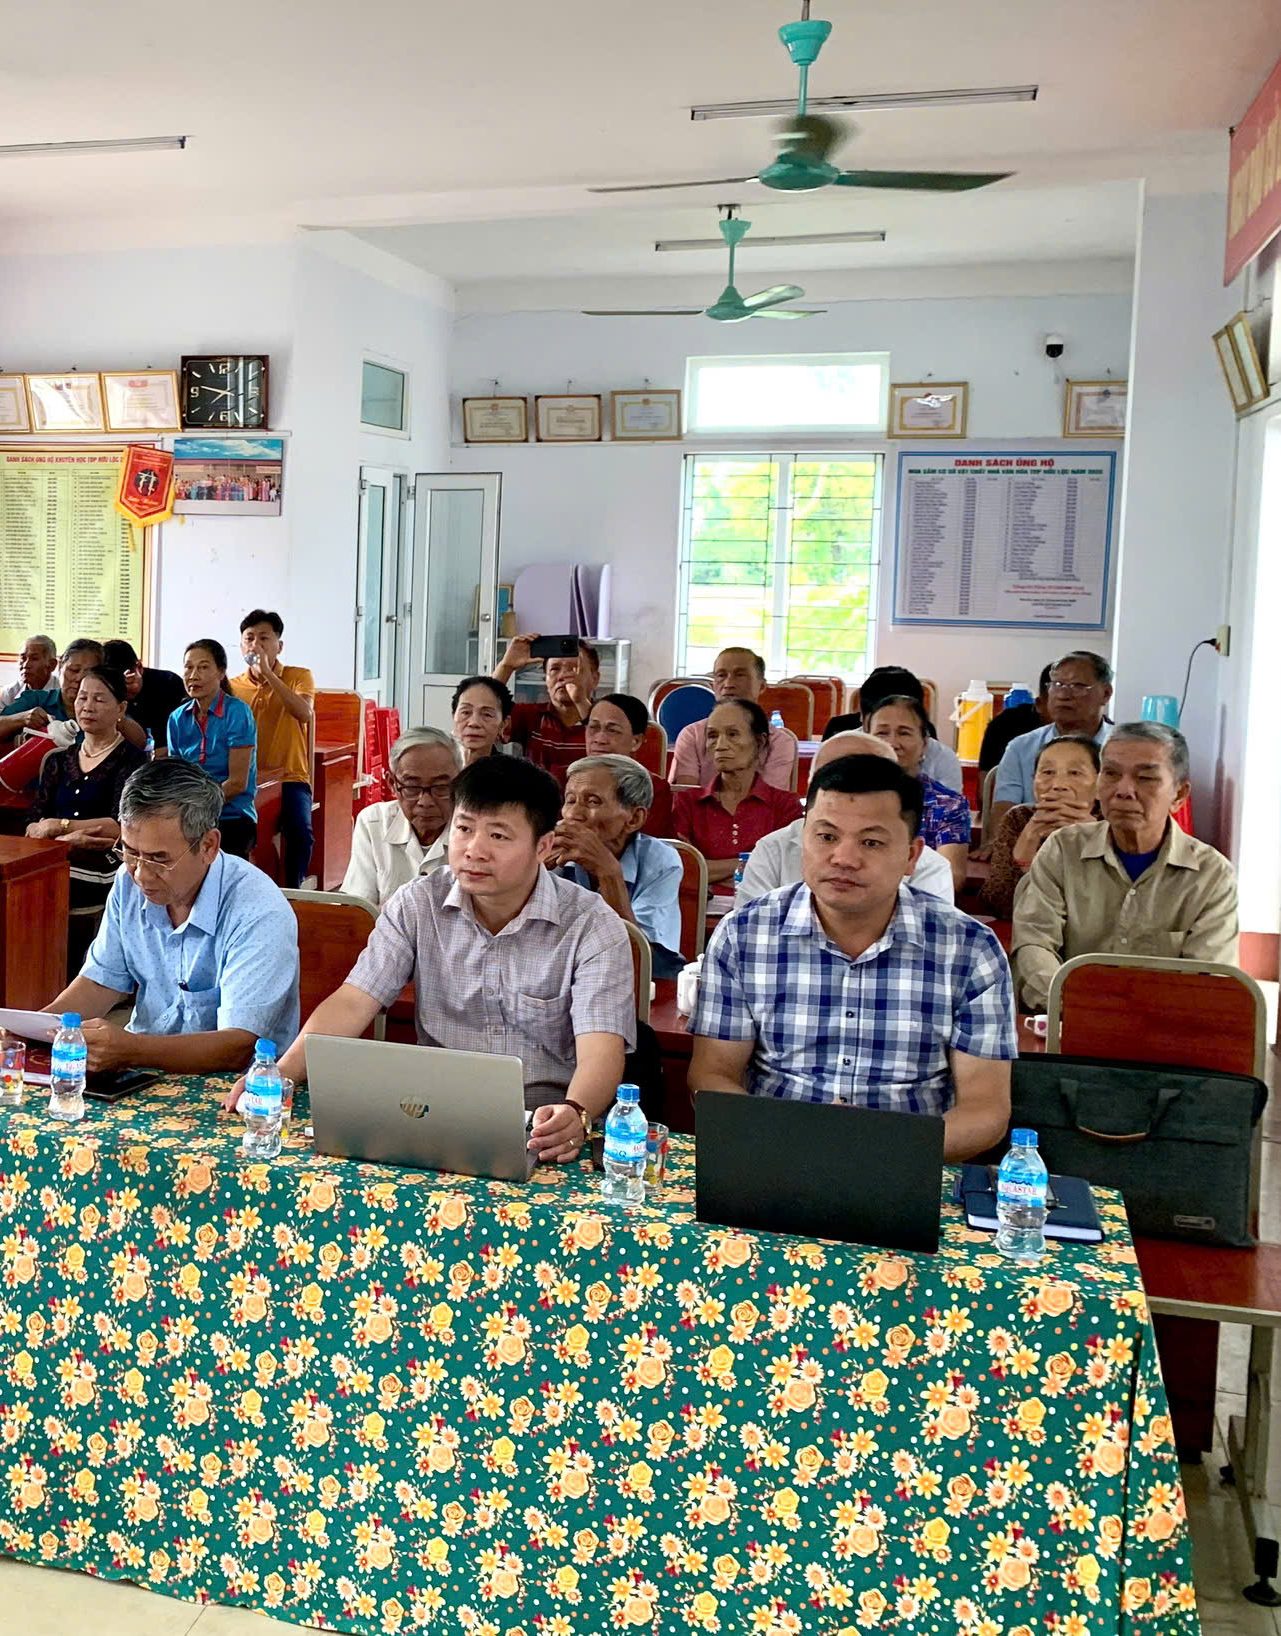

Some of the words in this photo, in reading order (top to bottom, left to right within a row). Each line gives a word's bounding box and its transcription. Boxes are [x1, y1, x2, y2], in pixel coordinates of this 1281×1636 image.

[190, 387, 199, 398] 9
[954, 459, 982, 467] DANH
[986, 458, 1013, 467] SÁCH
